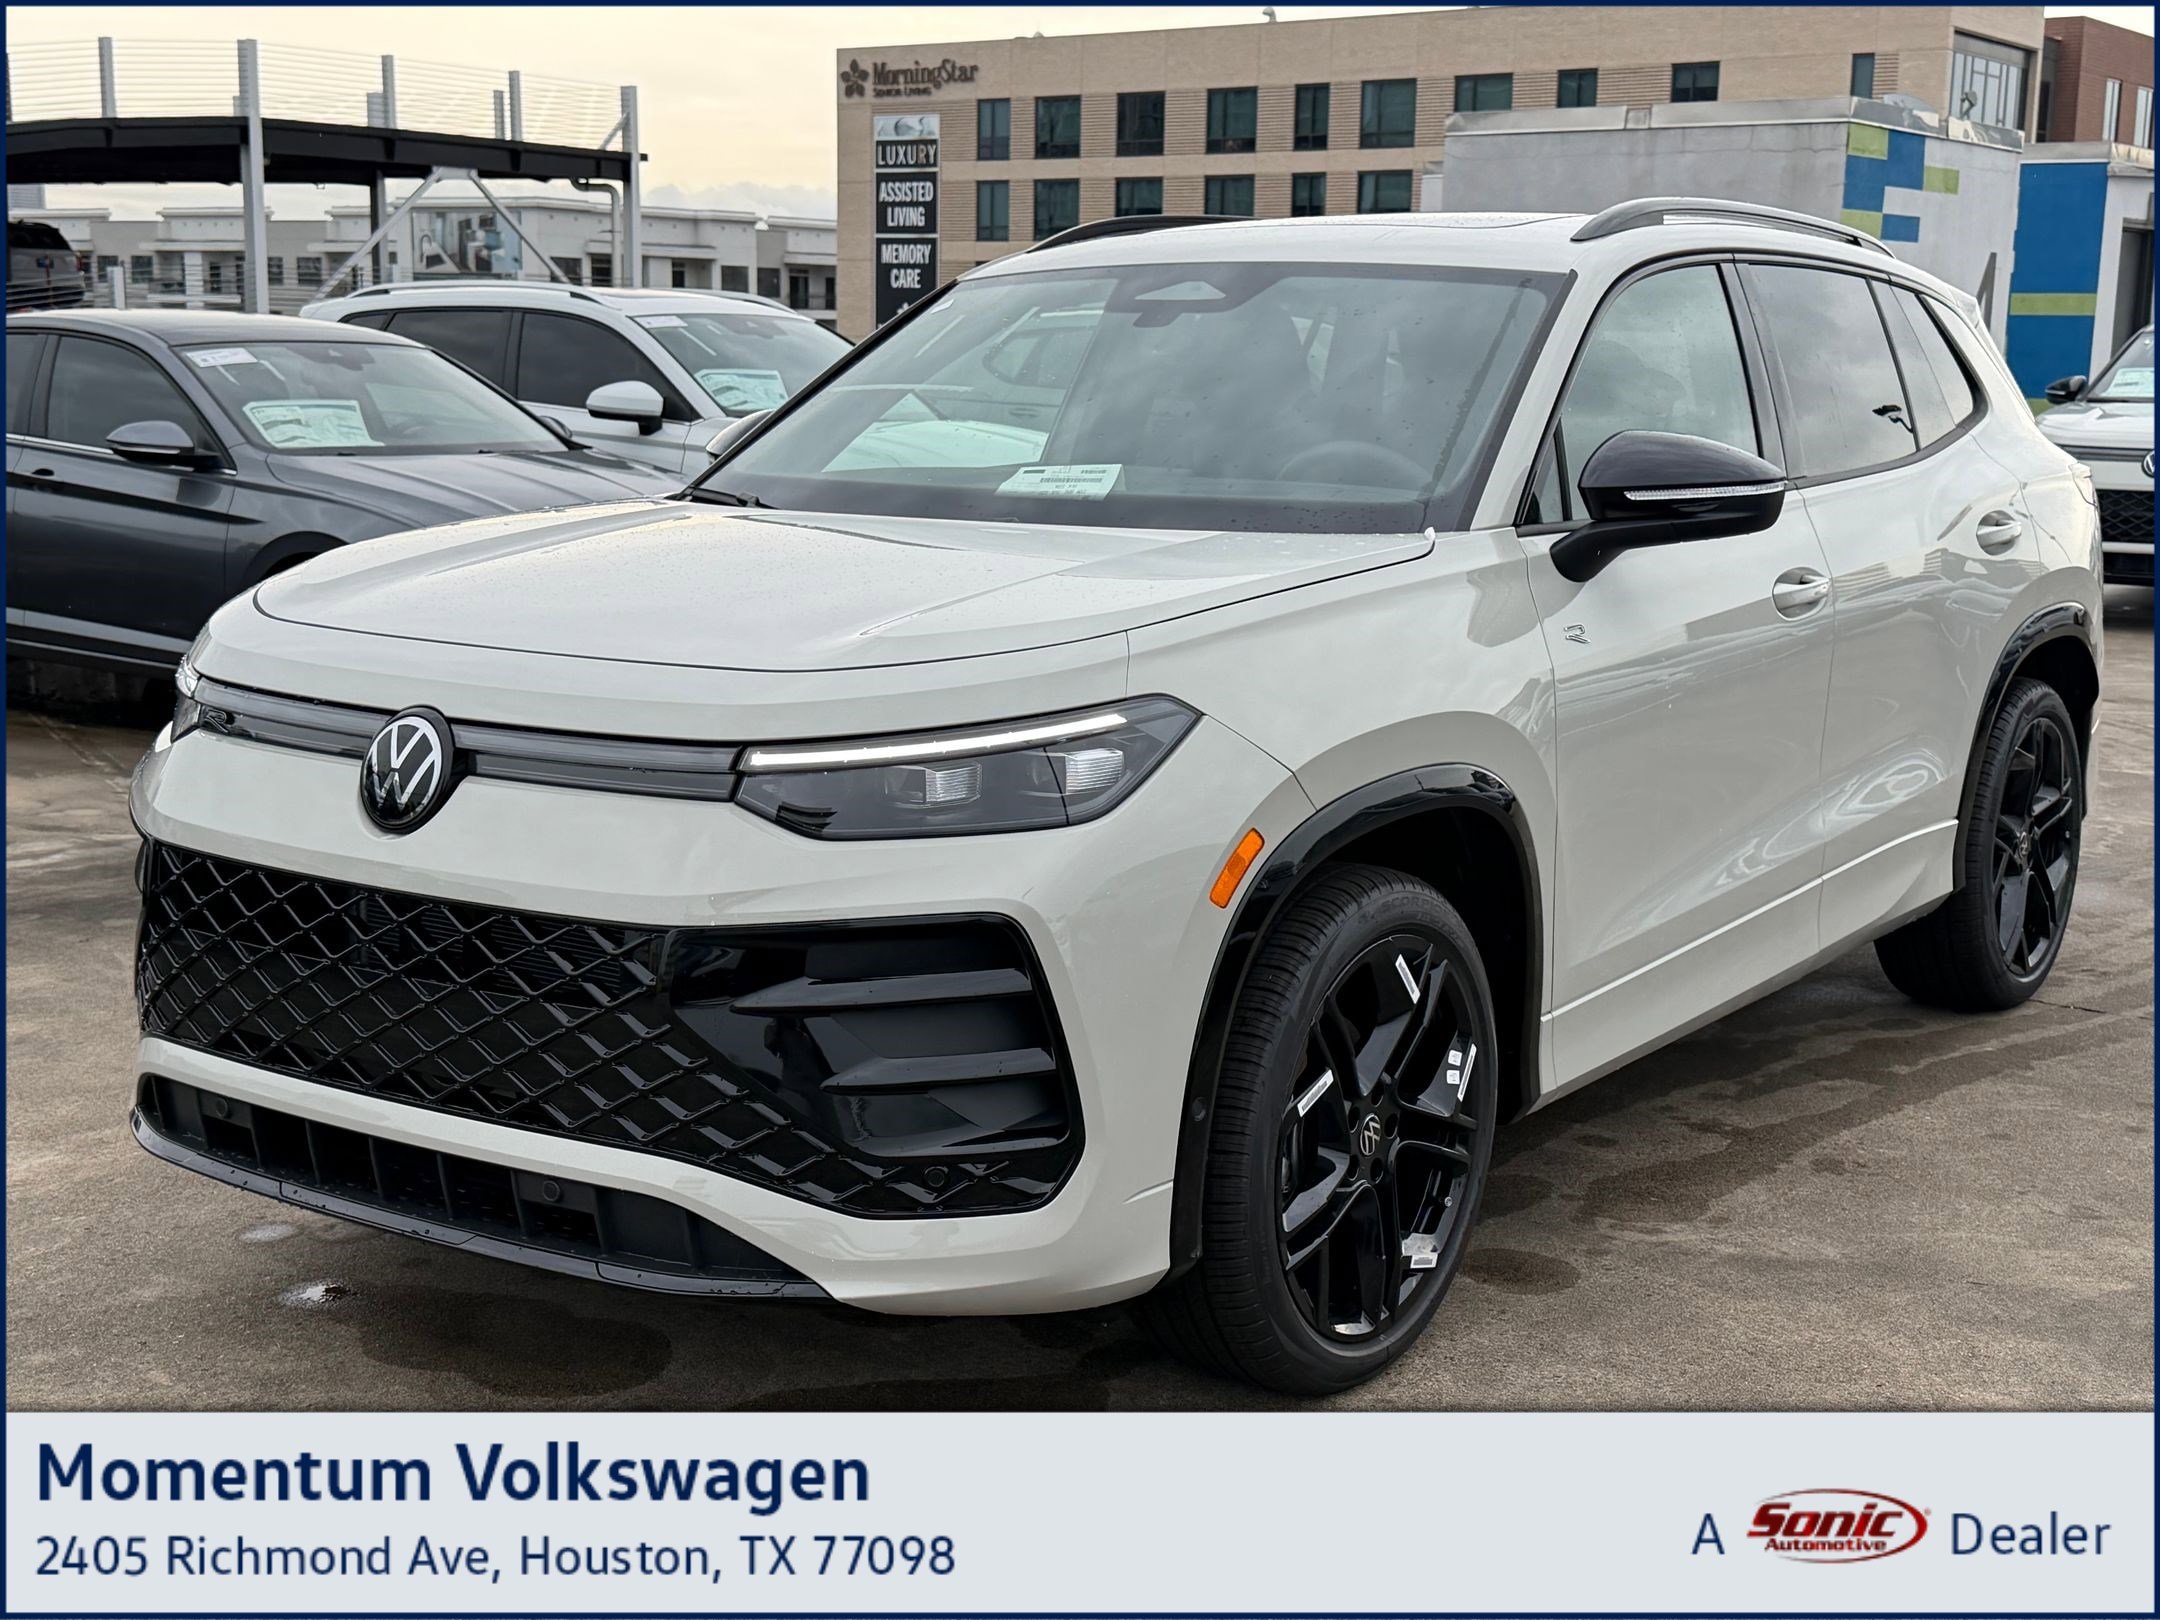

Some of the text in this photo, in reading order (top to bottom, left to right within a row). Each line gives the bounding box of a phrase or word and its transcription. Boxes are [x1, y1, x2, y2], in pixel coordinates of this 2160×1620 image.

[872, 59, 979, 90] MorningStar
[877, 143, 938, 166] LUXURY
[878, 181, 934, 202] ASSISTED
[886, 206, 925, 227] LIVING
[881, 243, 932, 264] MEMORY
[890, 268, 922, 289] CARE
